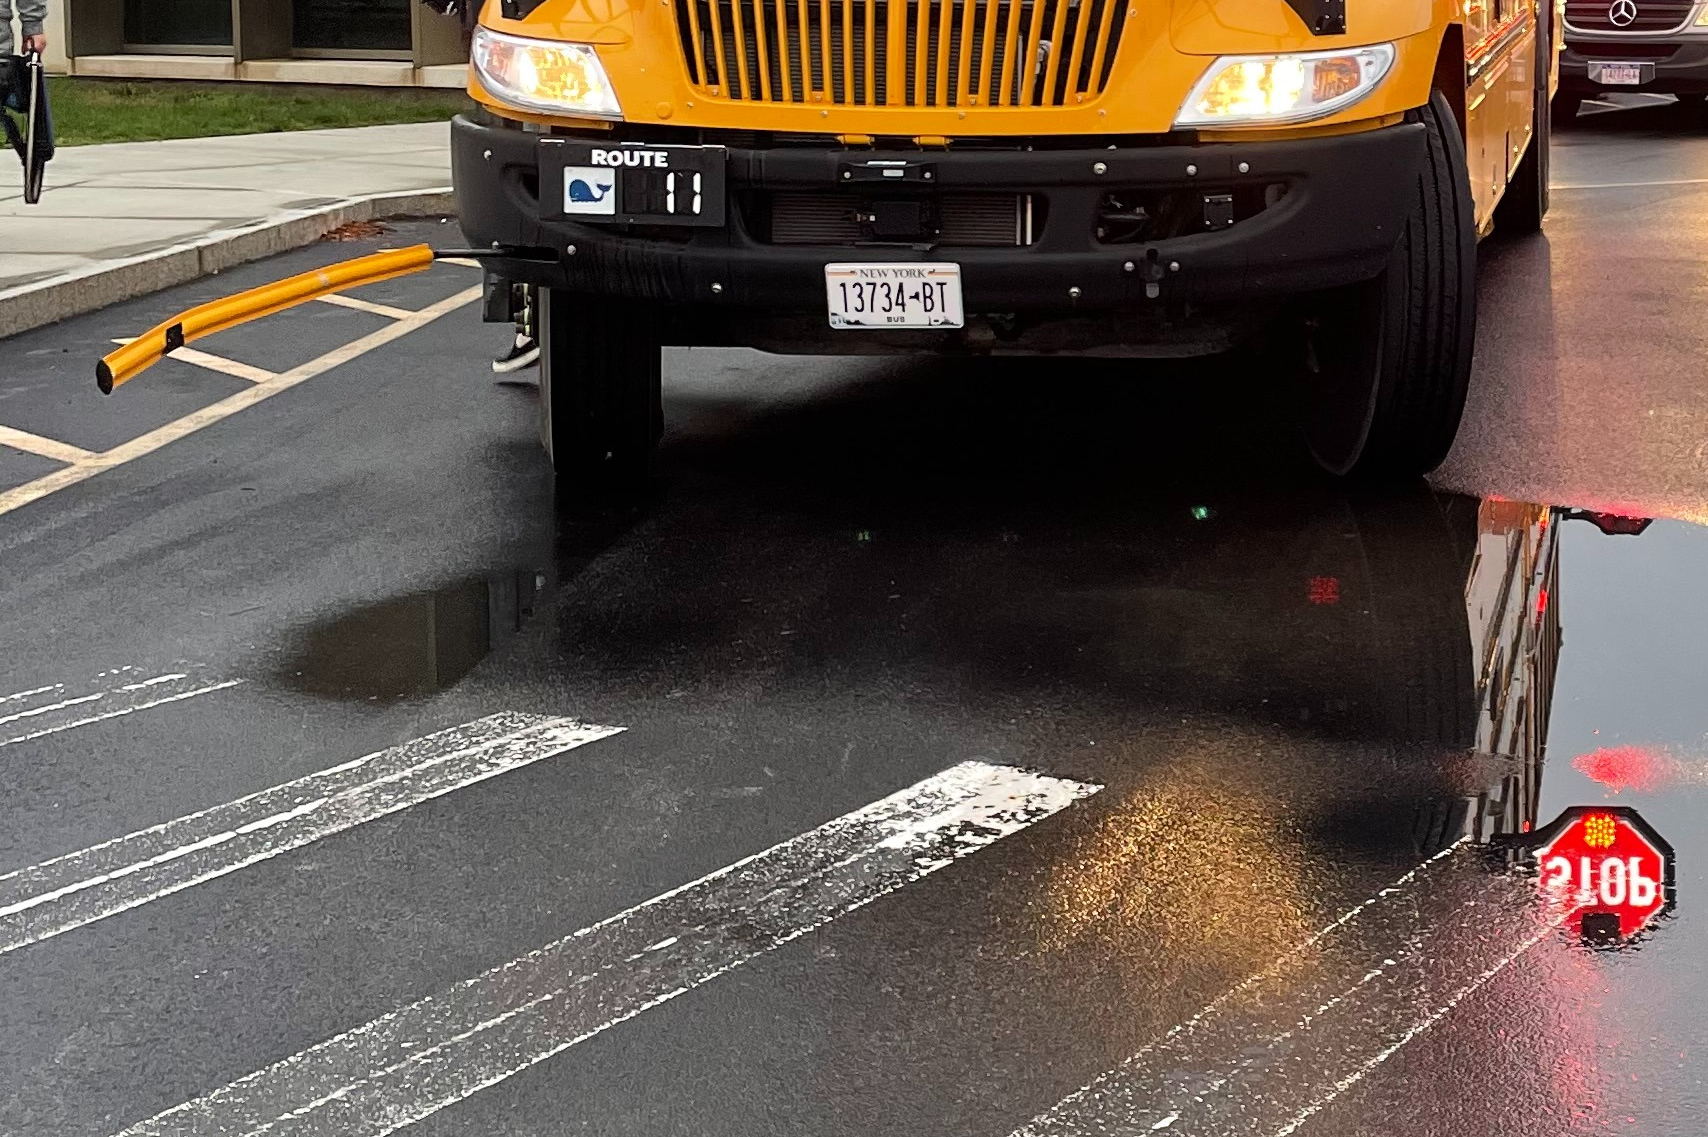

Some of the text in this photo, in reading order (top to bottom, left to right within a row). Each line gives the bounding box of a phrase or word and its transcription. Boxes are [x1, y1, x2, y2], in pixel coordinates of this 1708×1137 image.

[591, 149, 669, 168] ROUTE
[666, 171, 702, 215] 11
[859, 269, 927, 278] NEW YORK
